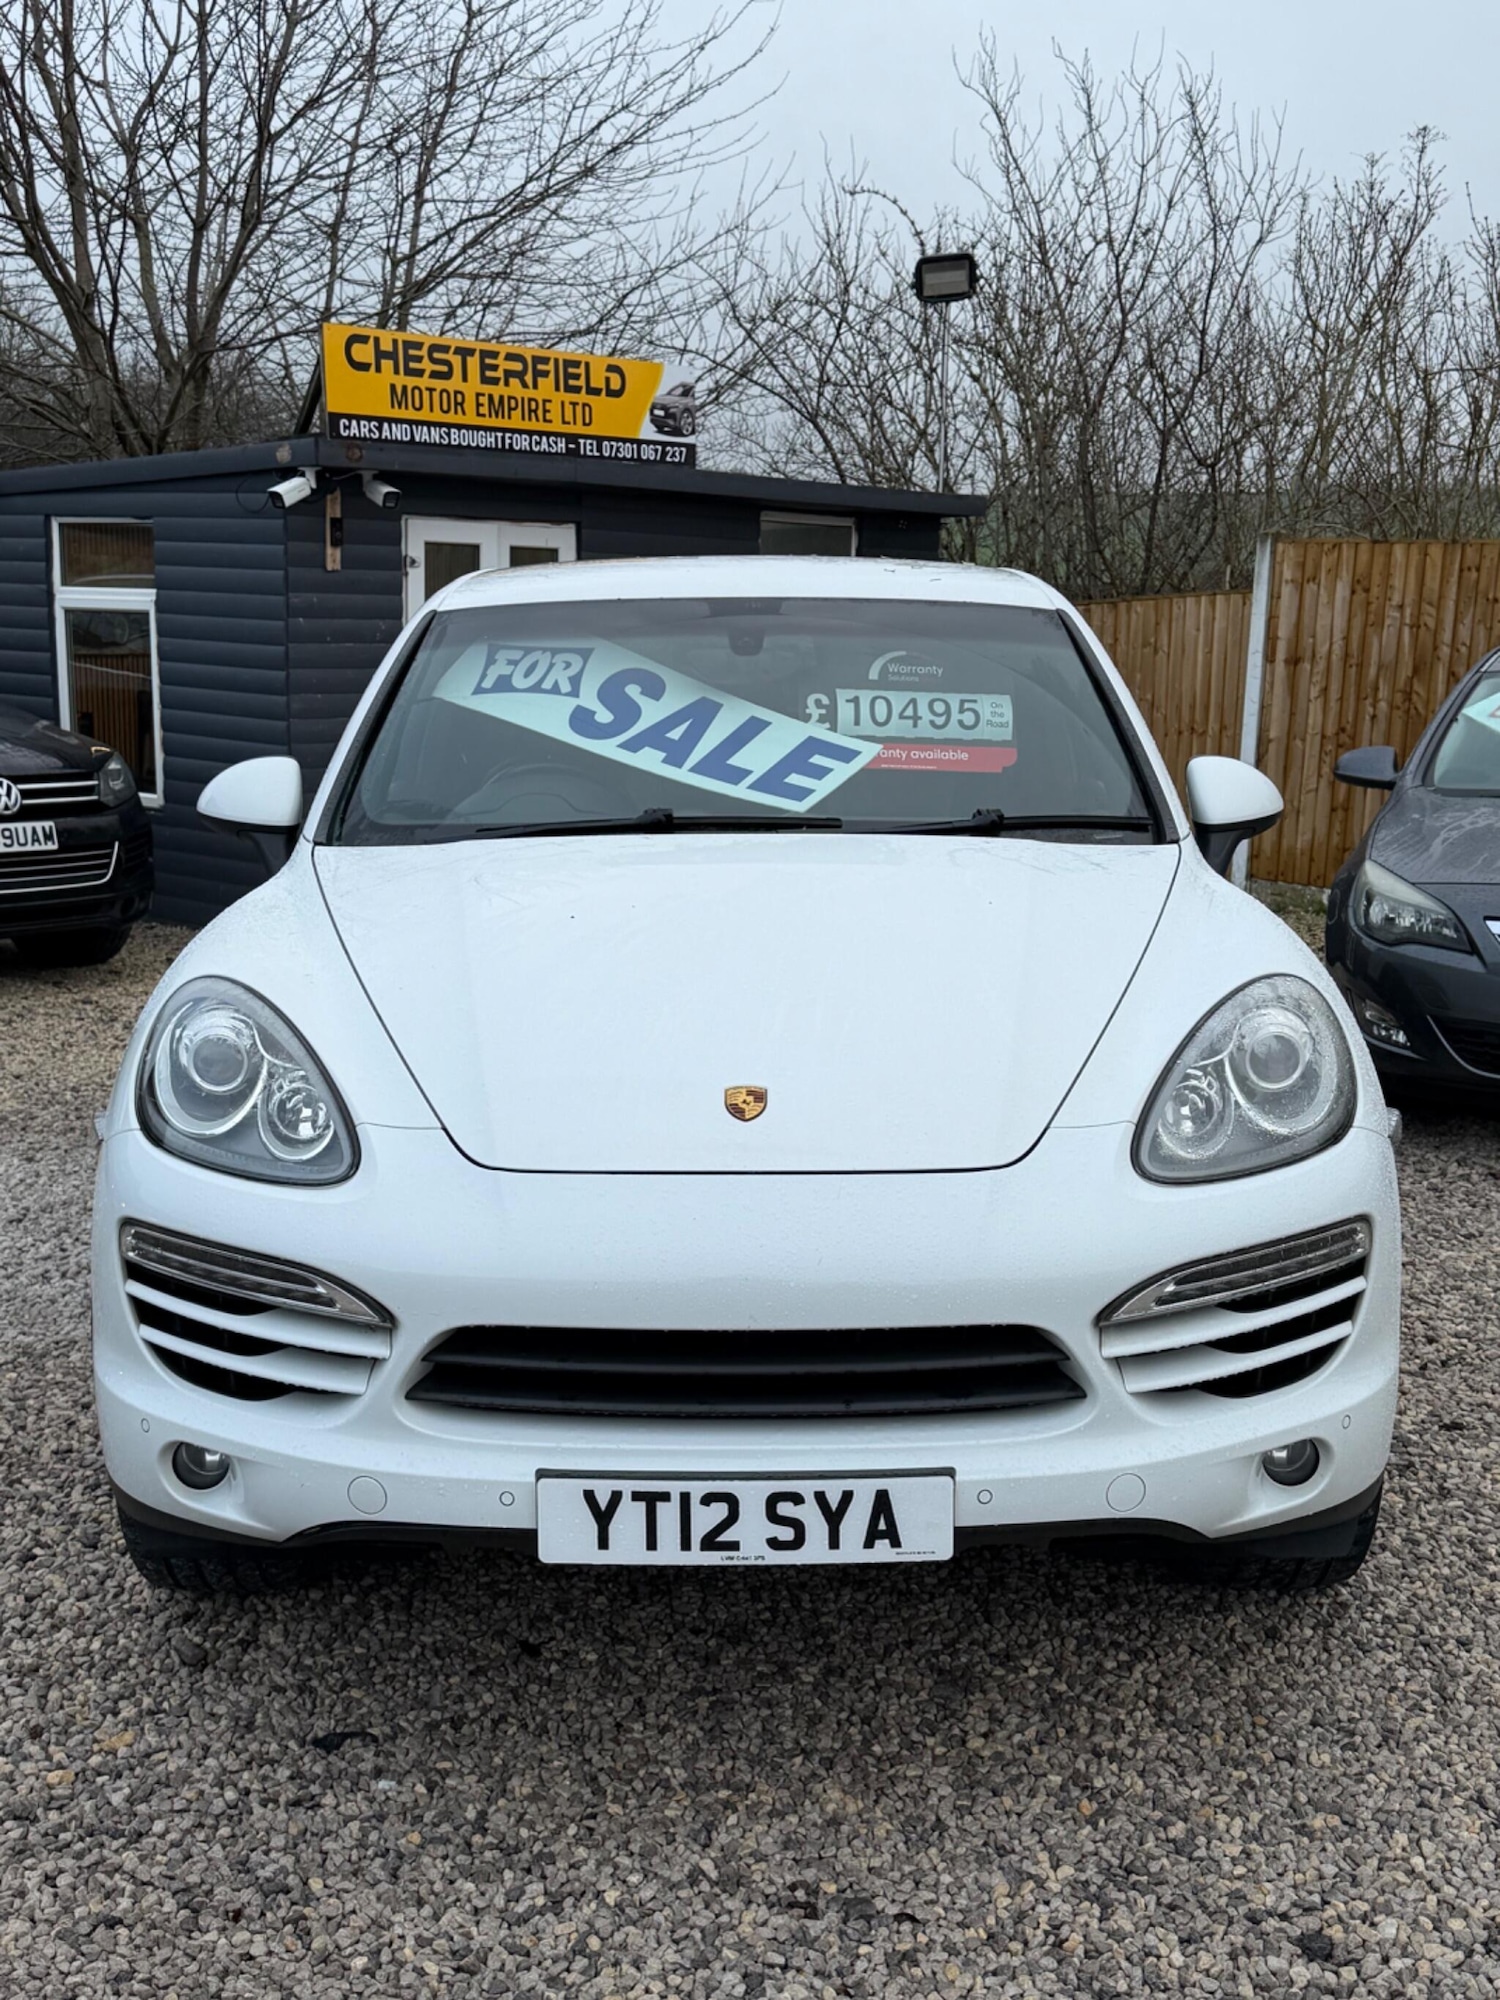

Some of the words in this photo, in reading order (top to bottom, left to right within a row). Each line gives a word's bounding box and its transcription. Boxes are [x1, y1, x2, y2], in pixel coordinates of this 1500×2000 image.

[344, 333, 626, 398] CHESTERFIELD
[389, 383, 466, 416] MOTOR
[476, 392, 553, 424] EMPIRE
[561, 400, 592, 427] LTD
[339, 418, 379, 440] CARS
[381, 422, 411, 442] AND
[413, 425, 449, 445] VANS
[450, 428, 503, 449] BOUGHT
[505, 433, 530, 451] FOR
[532, 435, 566, 453] CASH
[578, 439, 600, 456] TEL
[602, 441, 638, 459] 07301
[641, 444, 662, 461] 067
[666, 446, 687, 463] 237
[887, 662, 943, 677] Warranty
[990, 701, 1004, 709] On
[990, 710, 1005, 719] the
[482, 650, 583, 694] FOR
[568, 667, 863, 803] SALE
[986, 719, 1009, 729] Road
[876, 749, 907, 761] anty
[910, 749, 969, 761] available
[582, 1489, 741, 1552] YT12
[765, 1489, 902, 1551] SYA
